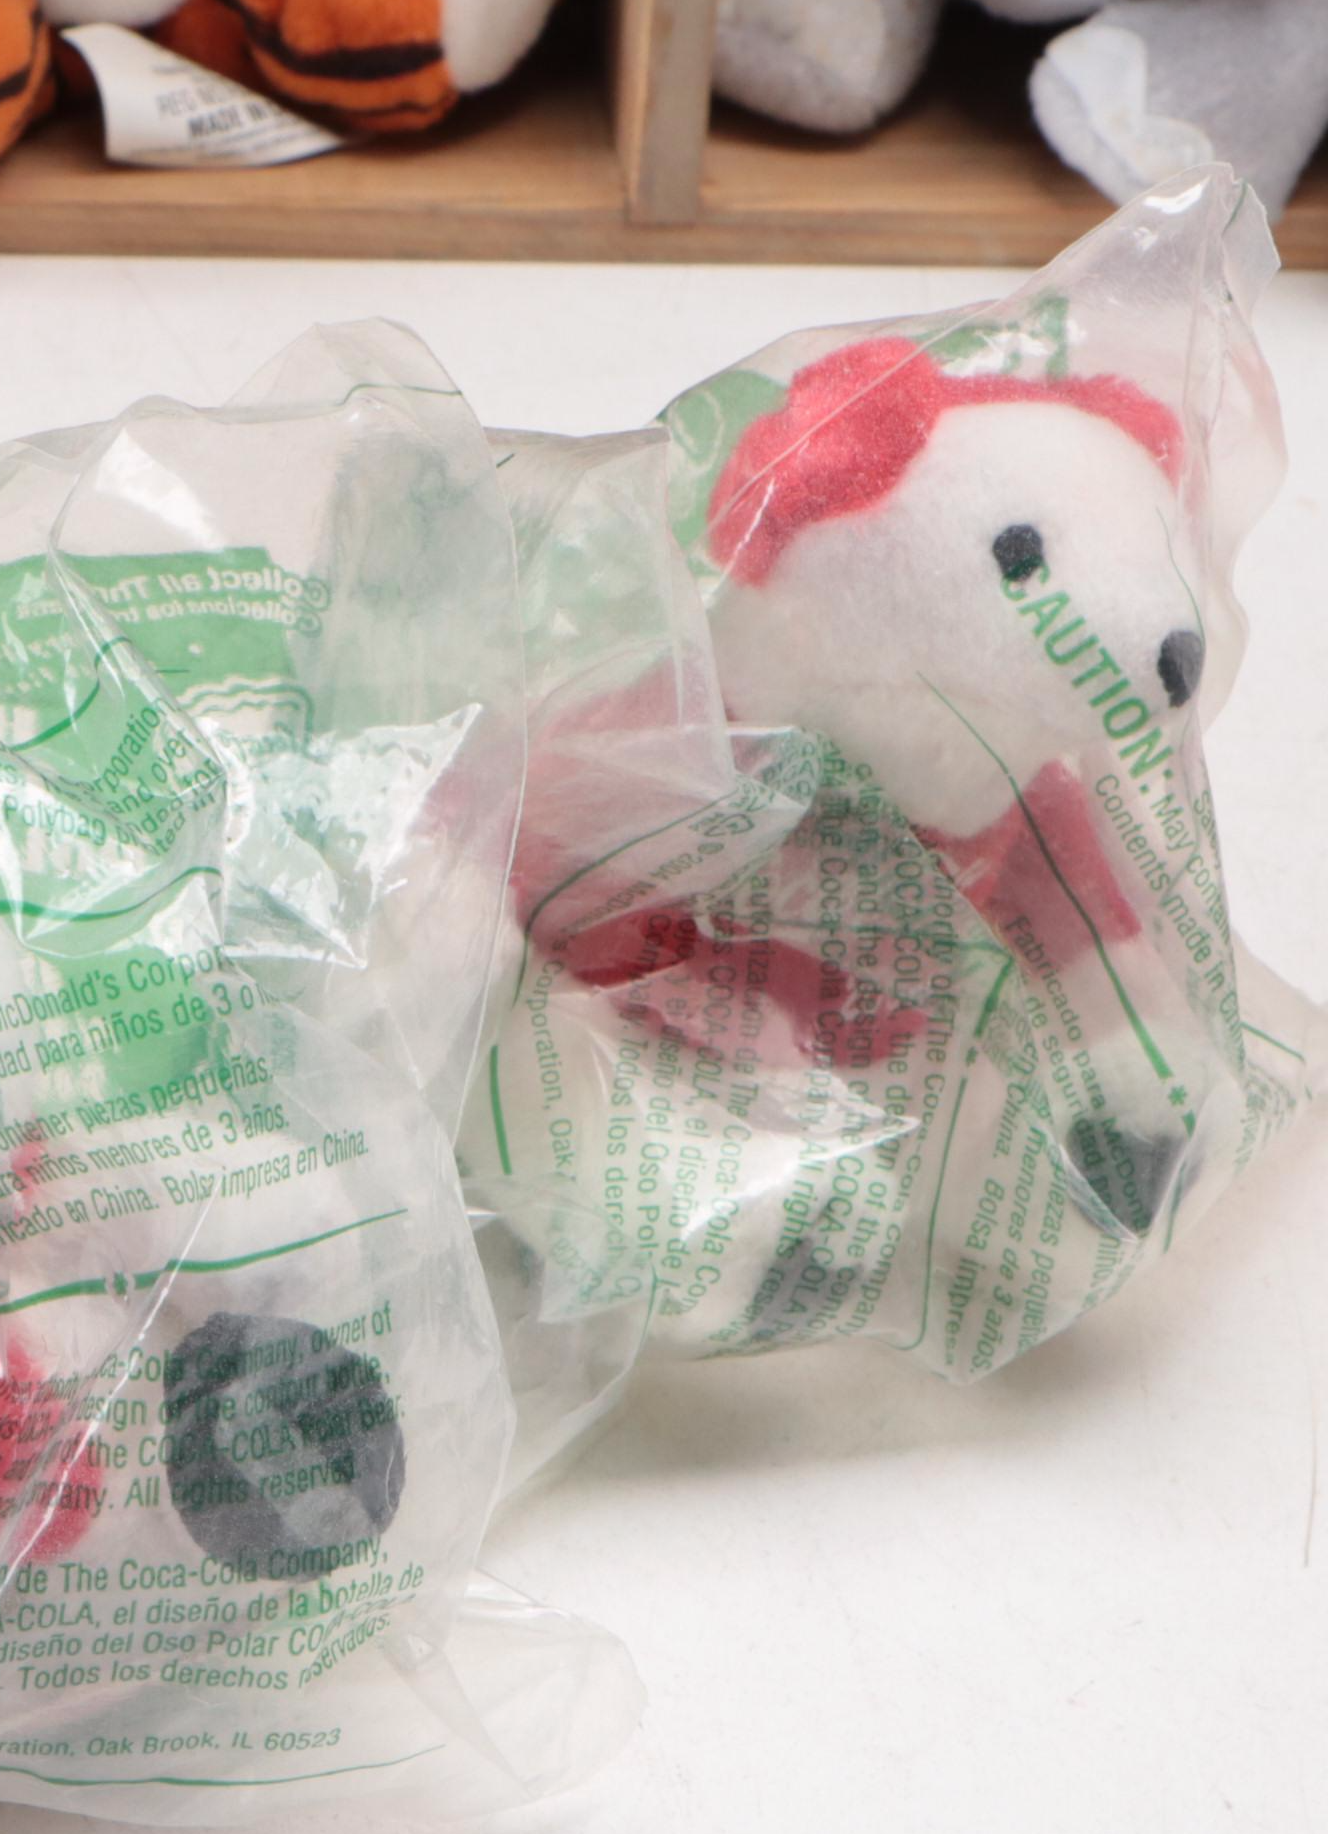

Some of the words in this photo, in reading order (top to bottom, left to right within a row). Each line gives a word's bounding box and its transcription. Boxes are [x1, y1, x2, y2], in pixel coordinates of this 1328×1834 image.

[999, 560, 1175, 795] CAUTION:
[1148, 792, 1199, 854] May
[2, 794, 108, 848] Polybag
[856, 863, 882, 915] and
[1094, 774, 1173, 893] Contents
[1158, 893, 1217, 964] made
[1203, 961, 1230, 995] in
[820, 856, 849, 1000] Coca-Cola
[856, 925, 883, 968] the
[34, 1032, 86, 1076] para
[87, 1008, 165, 1051] niños
[171, 993, 208, 1028] de
[212, 982, 233, 1017] 3
[239, 984, 255, 1011] o
[525, 960, 573, 1111] Corporation,
[685, 964, 737, 1107] COCA-COLA,
[844, 978, 884, 1069] design
[925, 1008, 956, 1063] The
[1004, 914, 1084, 1042] Fabricado
[1073, 1050, 1106, 1111] para
[609, 1039, 649, 1106] Todos
[652, 1025, 687, 1089] diseño
[733, 1046, 758, 1074] de
[885, 1032, 910, 1075] the
[1024, 995, 1048, 1030] de
[1045, 1035, 1106, 1168] seguridad
[79, 1090, 148, 1133] piezas
[151, 1055, 274, 1114] pequeñas.
[645, 1095, 676, 1133] del
[726, 1082, 760, 1118] The
[991, 1082, 1028, 1158] China.
[26, 1150, 90, 1188] niños
[89, 1135, 182, 1171] menores
[183, 1121, 215, 1154] de
[217, 1112, 239, 1145] 3
[242, 1102, 290, 1136] años.
[547, 1118, 575, 1168] Oak
[605, 1116, 635, 1156] los
[683, 1117, 710, 1138] el
[891, 1073, 946, 1212] Coca-Cola
[90, 1186, 161, 1222] China.
[219, 1155, 292, 1199] impresa
[295, 1145, 320, 1176] en
[321, 1127, 371, 1169] China.
[636, 1142, 669, 1194] Oso
[668, 1145, 708, 1228] diseño
[701, 1125, 752, 1256] Coca-Cola
[867, 1181, 890, 1209] of
[1006, 1127, 1048, 1243] menores
[776, 1180, 818, 1260] rights
[784, 1154, 865, 1315] COCA-COLA
[846, 1217, 879, 1259] the
[965, 1177, 1005, 1250] Bolsa
[660, 1237, 691, 1270] de
[836, 1223, 903, 1335] Company
[997, 1247, 1020, 1282] de
[310, 1316, 367, 1352] owner
[370, 1300, 393, 1338] of
[991, 1285, 1014, 1308] 3
[969, 1308, 1005, 1374] años.
[84, 1437, 129, 1470] the
[137, 1419, 297, 1469] COCA-COLA
[358, 1393, 407, 1432] Bear.
[123, 1476, 161, 1509] All
[14, 1562, 49, 1595] de
[58, 1560, 110, 1595] The
[118, 1551, 260, 1592] Coca-Cola
[270, 1535, 390, 1579] Company,
[113, 1597, 138, 1627] el
[145, 1593, 237, 1627] diseño
[246, 1592, 280, 1623] de
[288, 1587, 311, 1619] la
[318, 1572, 395, 1617] botella
[397, 1562, 427, 1593] de
[17, 1662, 101, 1691] Todos
[111, 1661, 152, 1683] los
[159, 1657, 290, 1691] derechos
[91, 1624, 135, 1656] del
[140, 1627, 198, 1654] Oso
[205, 1625, 282, 1660] Polar
[86, 1736, 135, 1758] Oak
[141, 1730, 221, 1756] Brook,
[231, 1731, 255, 1751] IL
[263, 1728, 344, 1752] 60523
